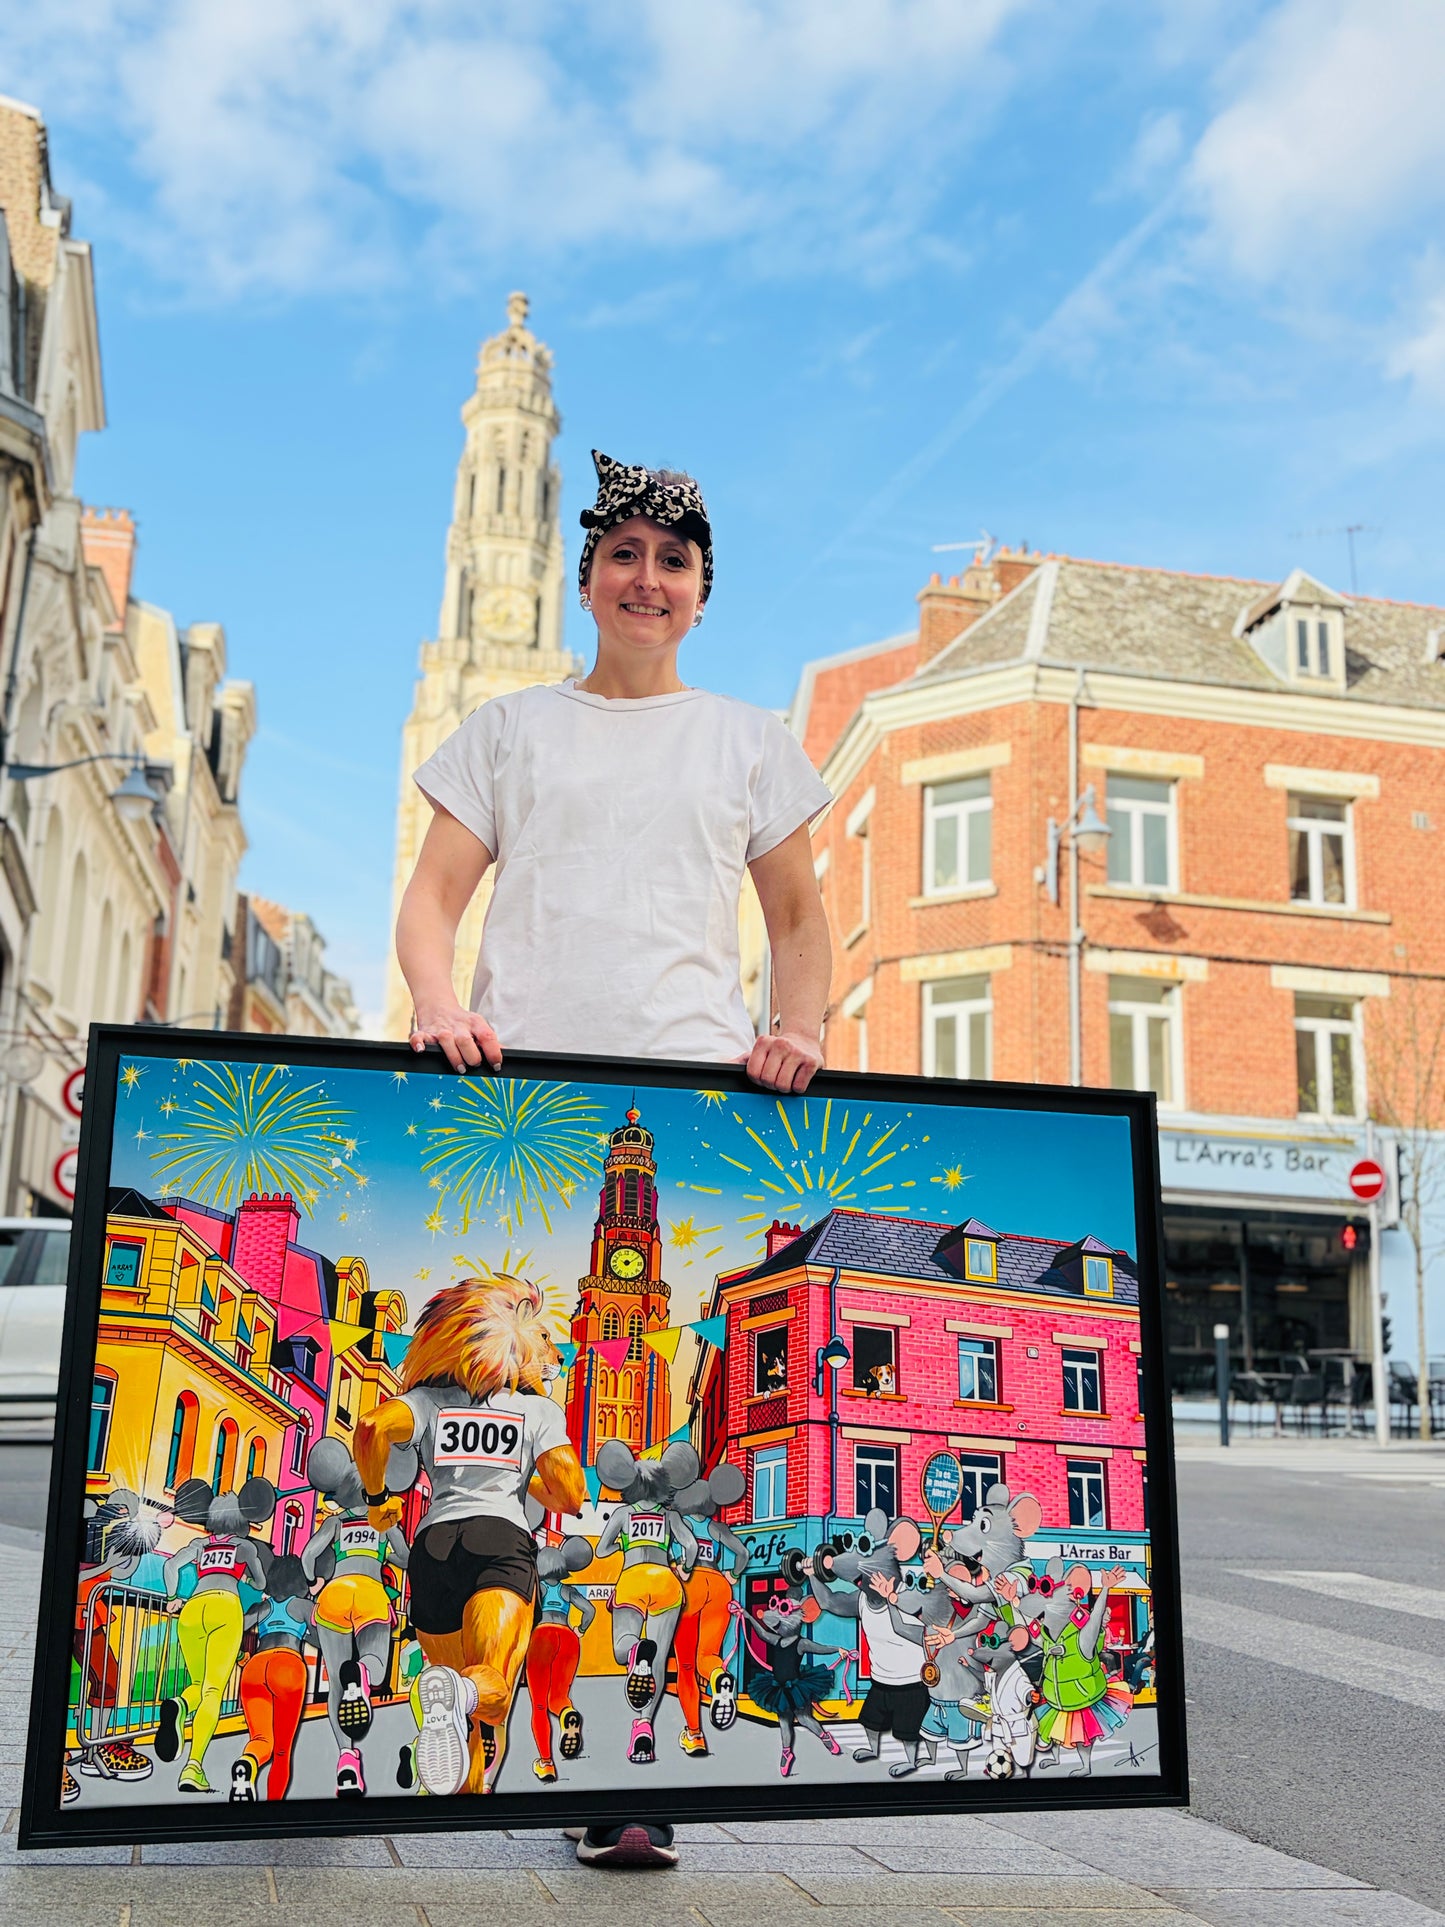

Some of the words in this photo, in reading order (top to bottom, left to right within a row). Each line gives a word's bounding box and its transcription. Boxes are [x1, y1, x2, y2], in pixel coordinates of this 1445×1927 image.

[1174, 1139, 1273, 1170] L'Arra's
[1284, 1148, 1330, 1172] Bar
[440, 1420, 519, 1456] 3009
[342, 1529, 377, 1544] 1994
[631, 1521, 663, 1538] 2017
[742, 1533, 787, 1565] Café
[1059, 1543, 1105, 1559] L'Arras
[1108, 1545, 1132, 1560] Bar
[201, 1550, 233, 1567] 2475
[426, 1714, 448, 1724] LOVE
